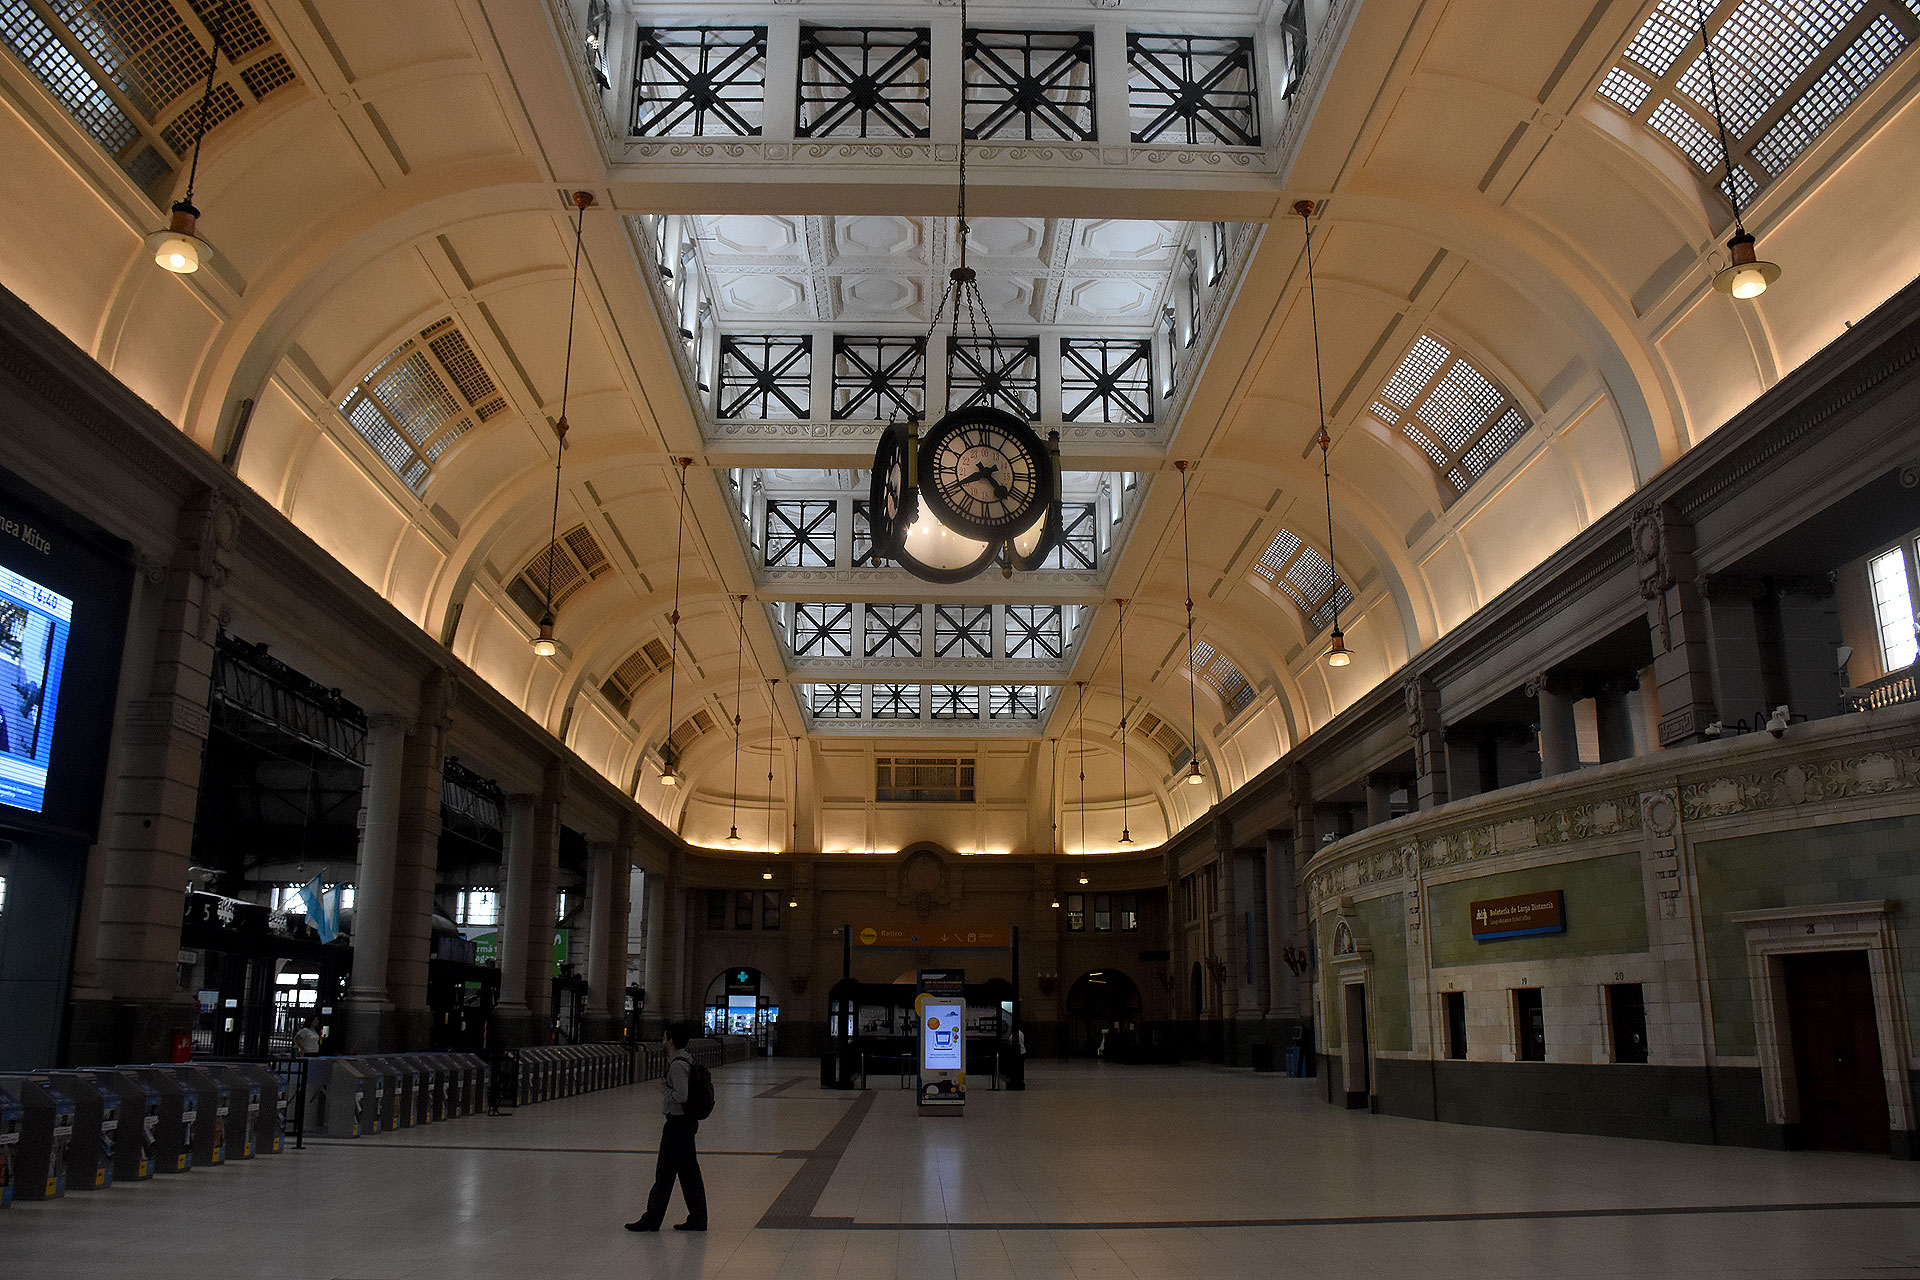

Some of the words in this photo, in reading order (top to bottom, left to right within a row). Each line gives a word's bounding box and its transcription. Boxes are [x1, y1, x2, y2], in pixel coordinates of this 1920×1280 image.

[21, 524, 51, 555] Mitre
[203, 903, 211, 921] 5
[1517, 905, 1530, 914] Larga
[1531, 902, 1553, 910] Distancia
[881, 929, 903, 937] Retiro
[1614, 971, 1624, 981] 20
